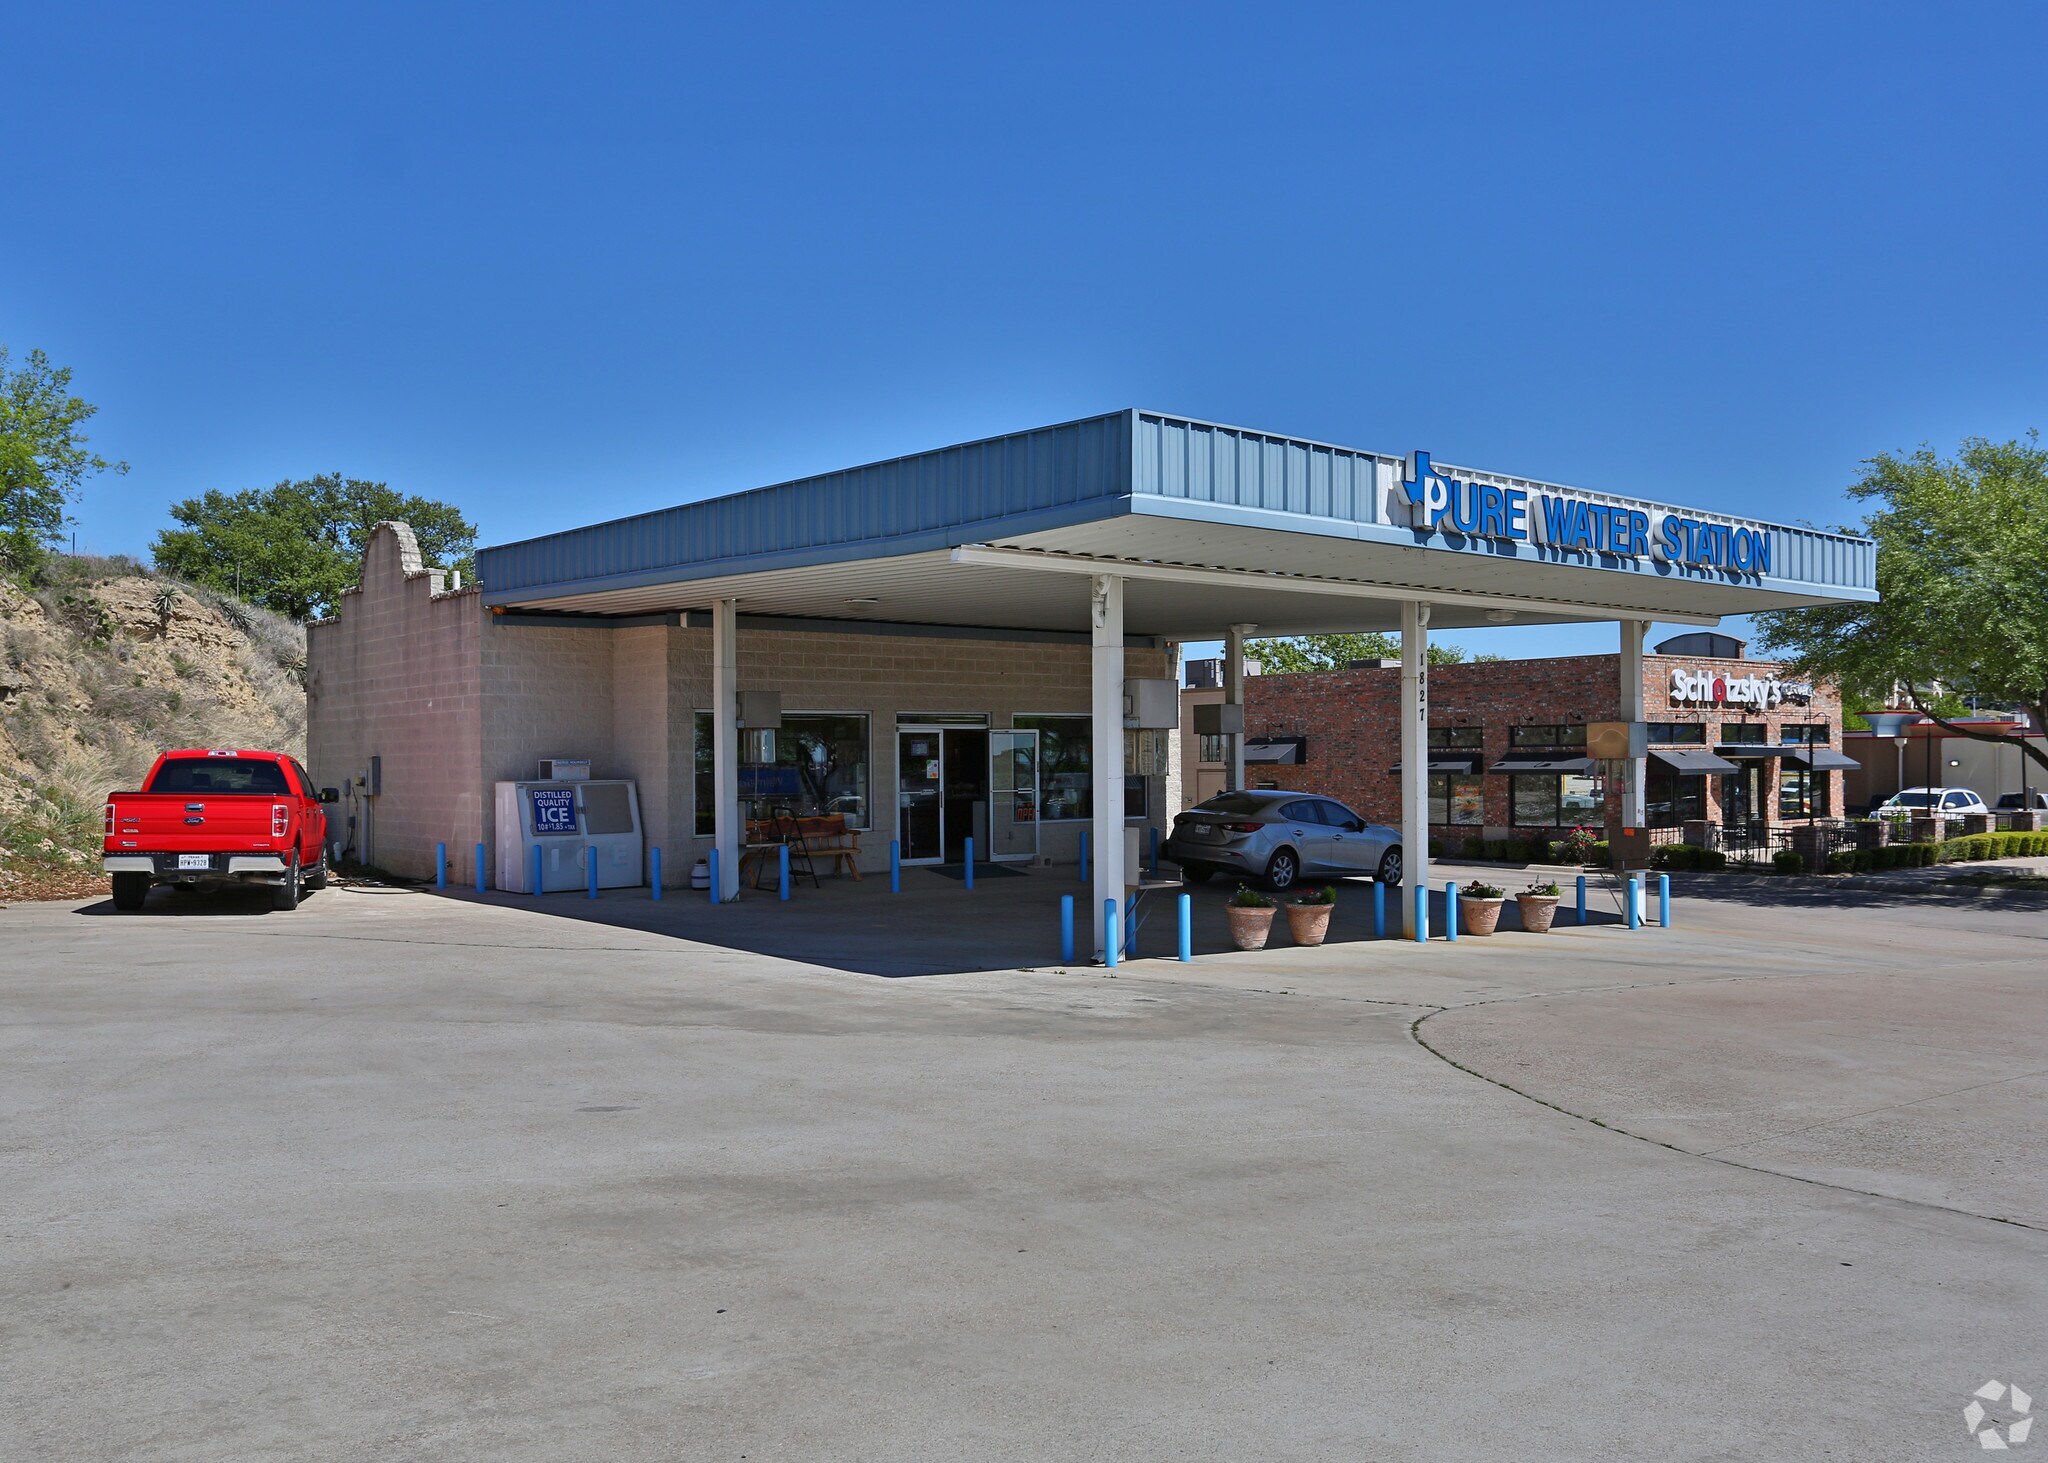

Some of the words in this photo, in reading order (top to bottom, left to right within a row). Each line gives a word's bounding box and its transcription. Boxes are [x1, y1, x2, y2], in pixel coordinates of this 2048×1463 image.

[1423, 475, 1528, 540] PURE
[1541, 494, 1649, 555] WATER
[1661, 514, 1771, 573] STATION
[1670, 668, 1781, 709] Schlotzsky's
[534, 791, 572, 799] DISTILLED
[537, 799, 570, 807] QUALITY
[541, 807, 569, 823] ICE
